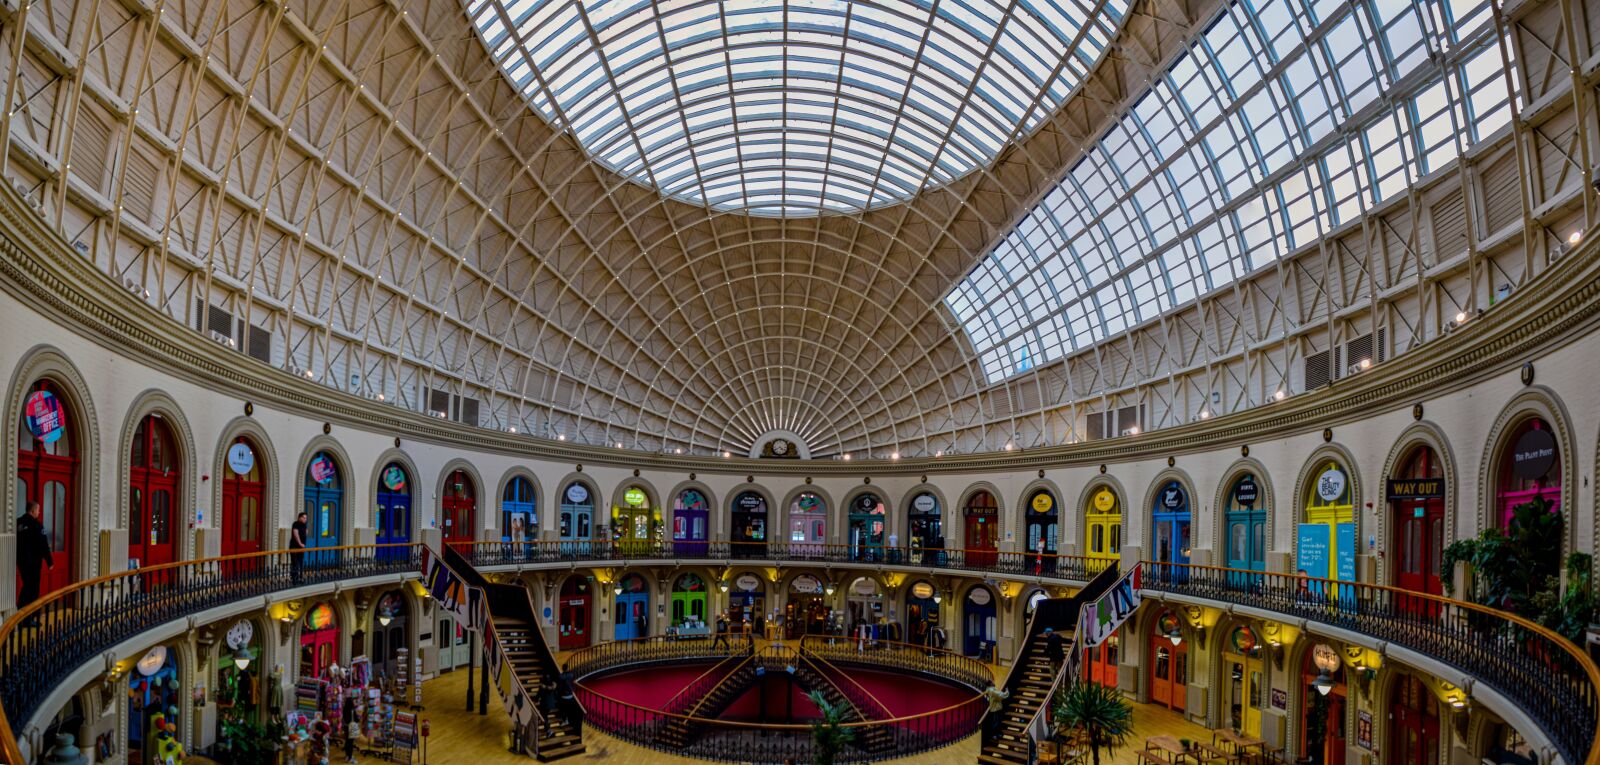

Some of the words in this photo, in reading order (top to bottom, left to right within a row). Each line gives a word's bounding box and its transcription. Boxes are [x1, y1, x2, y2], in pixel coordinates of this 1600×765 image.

[42, 418, 60, 432] OFFICE
[1515, 454, 1524, 462] THE
[1525, 451, 1538, 460] PLANT
[1539, 448, 1553, 457] POINT
[1321, 482, 1339, 490] BEAUTY
[1321, 488, 1336, 496] CLINIC
[1393, 483, 1416, 494] WAY
[1418, 482, 1438, 494] OUT
